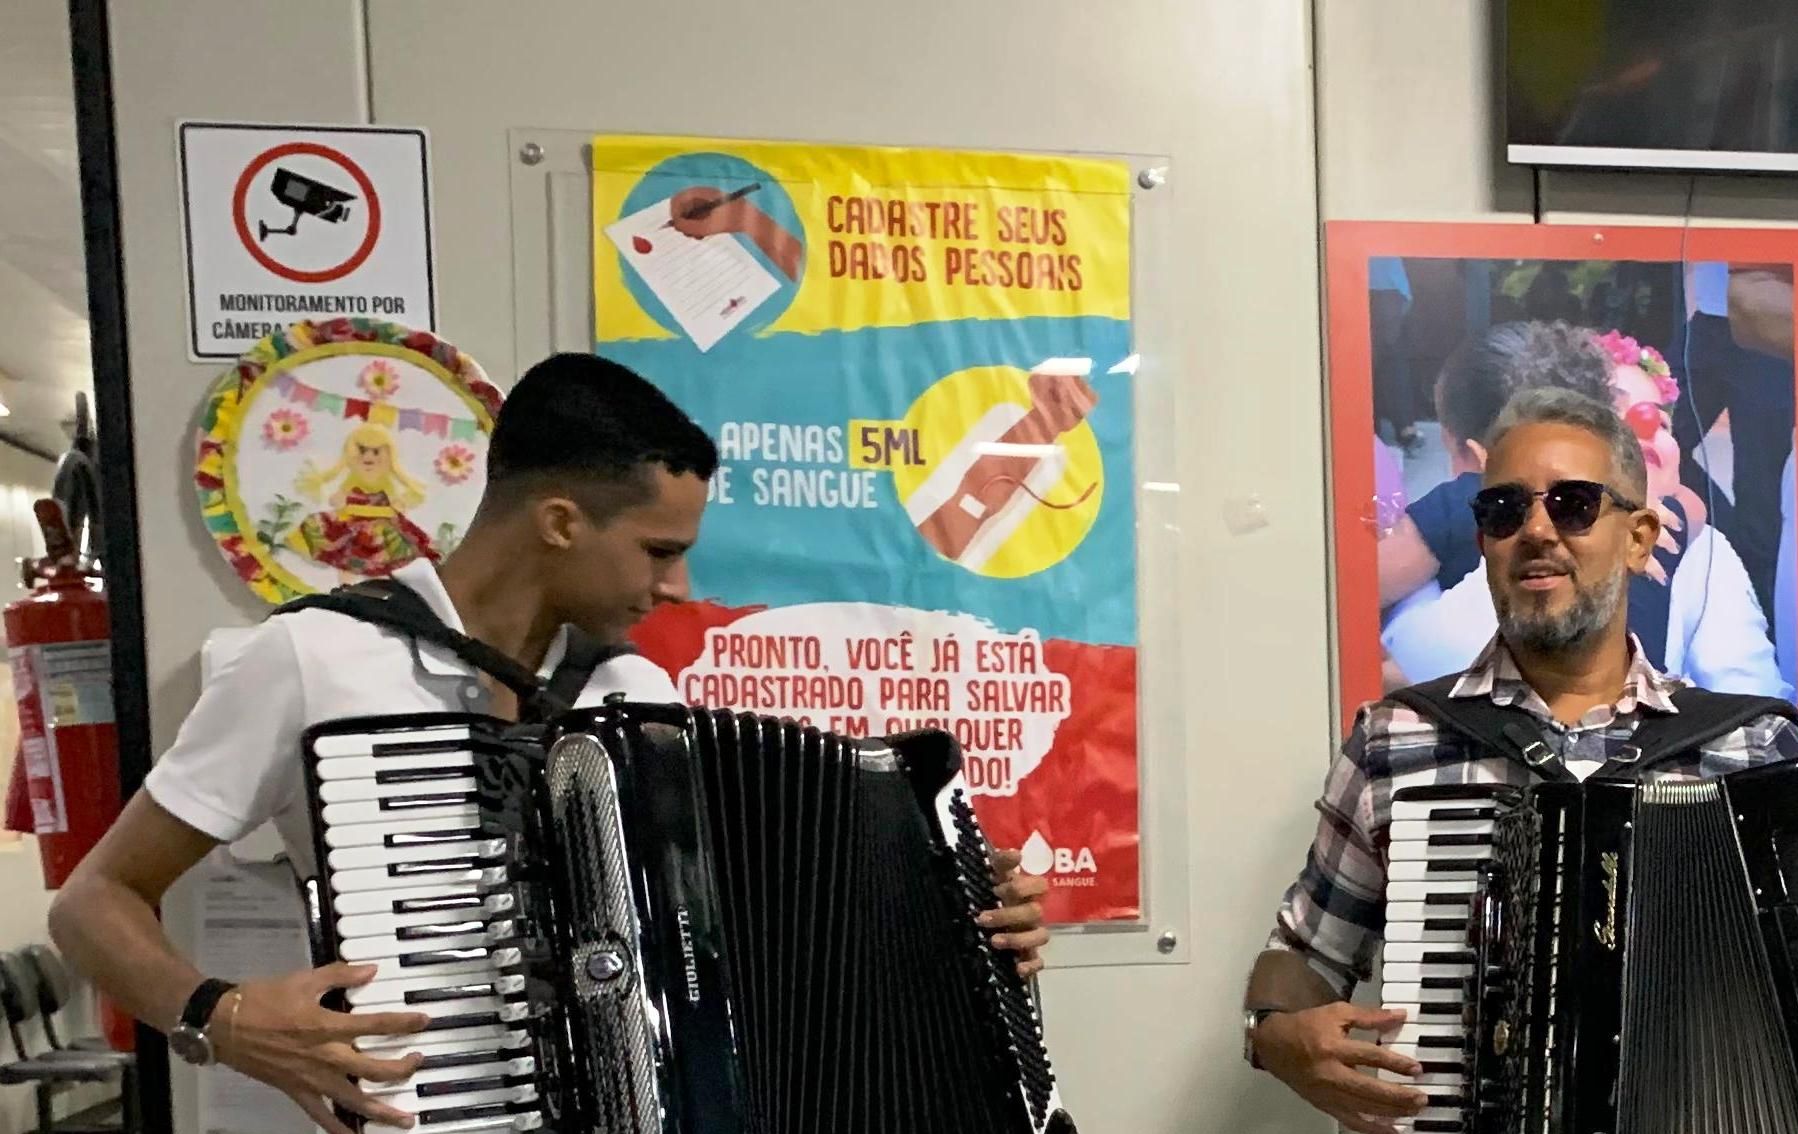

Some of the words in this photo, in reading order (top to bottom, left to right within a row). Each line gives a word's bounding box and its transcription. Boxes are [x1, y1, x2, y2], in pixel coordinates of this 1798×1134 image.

[827, 195, 979, 240] CADASTRE
[997, 204, 1068, 246] SEUS
[828, 240, 927, 283] DADOS
[945, 247, 1083, 291] PESSOAIS
[220, 294, 368, 314] MONITORAMENTO
[372, 296, 405, 314] POR
[720, 421, 844, 464] APENAS
[861, 427, 927, 466] 5ML
[752, 467, 879, 508] SANGUE
[712, 634, 829, 673] PRONTO,
[846, 630, 914, 672] VOCÊ
[931, 633, 960, 673] JÁ
[976, 632, 1037, 674] ESTÁ
[684, 674, 863, 710] CADASTRADO
[880, 677, 950, 711] PARA
[967, 679, 1065, 713] SALVAR
[1052, 877, 1096, 887] SANGUE
